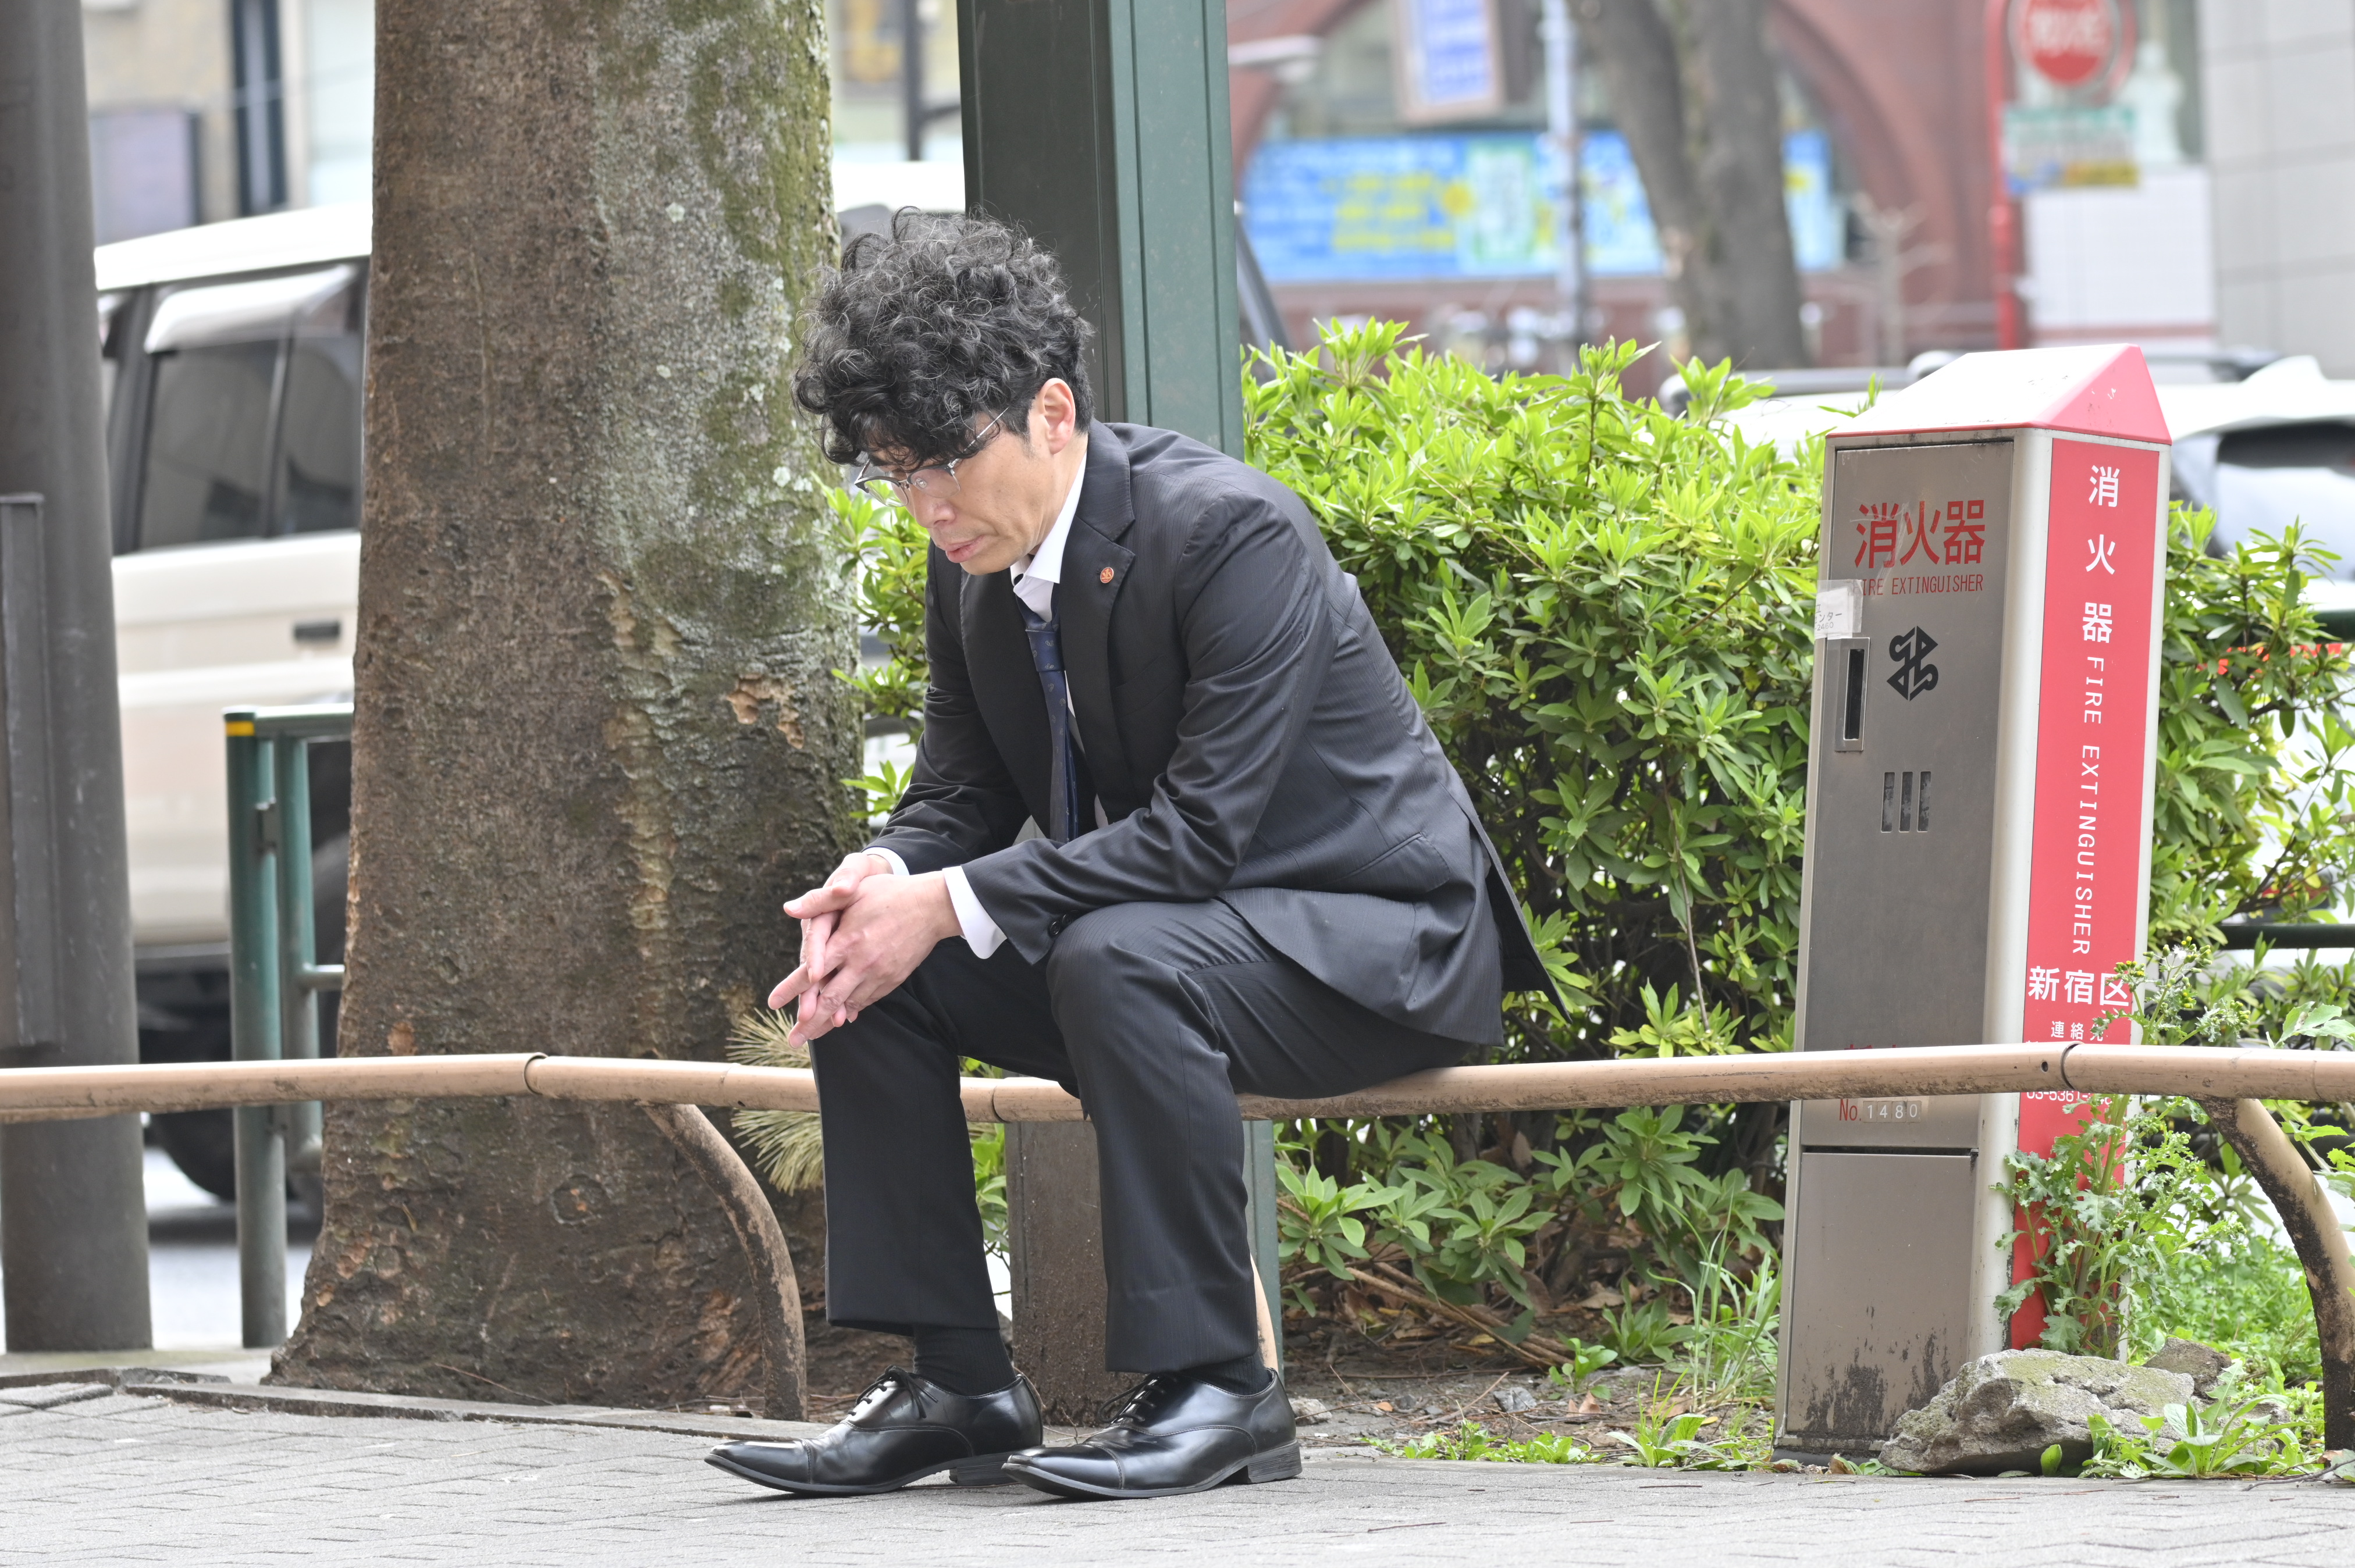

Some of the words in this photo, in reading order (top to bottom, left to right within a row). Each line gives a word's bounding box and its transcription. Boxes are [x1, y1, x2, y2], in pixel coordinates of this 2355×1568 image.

[1854, 499, 1986, 569] 消火器
[2082, 465, 2120, 644] 消火器
[1891, 574, 1983, 595] EXTINGUISHER
[2084, 657, 2104, 724] FIRE
[2072, 745, 2100, 955] EXTINGUISHER
[2027, 965, 2129, 1007] 新宿区
[1867, 1104, 1918, 1119] 1480
